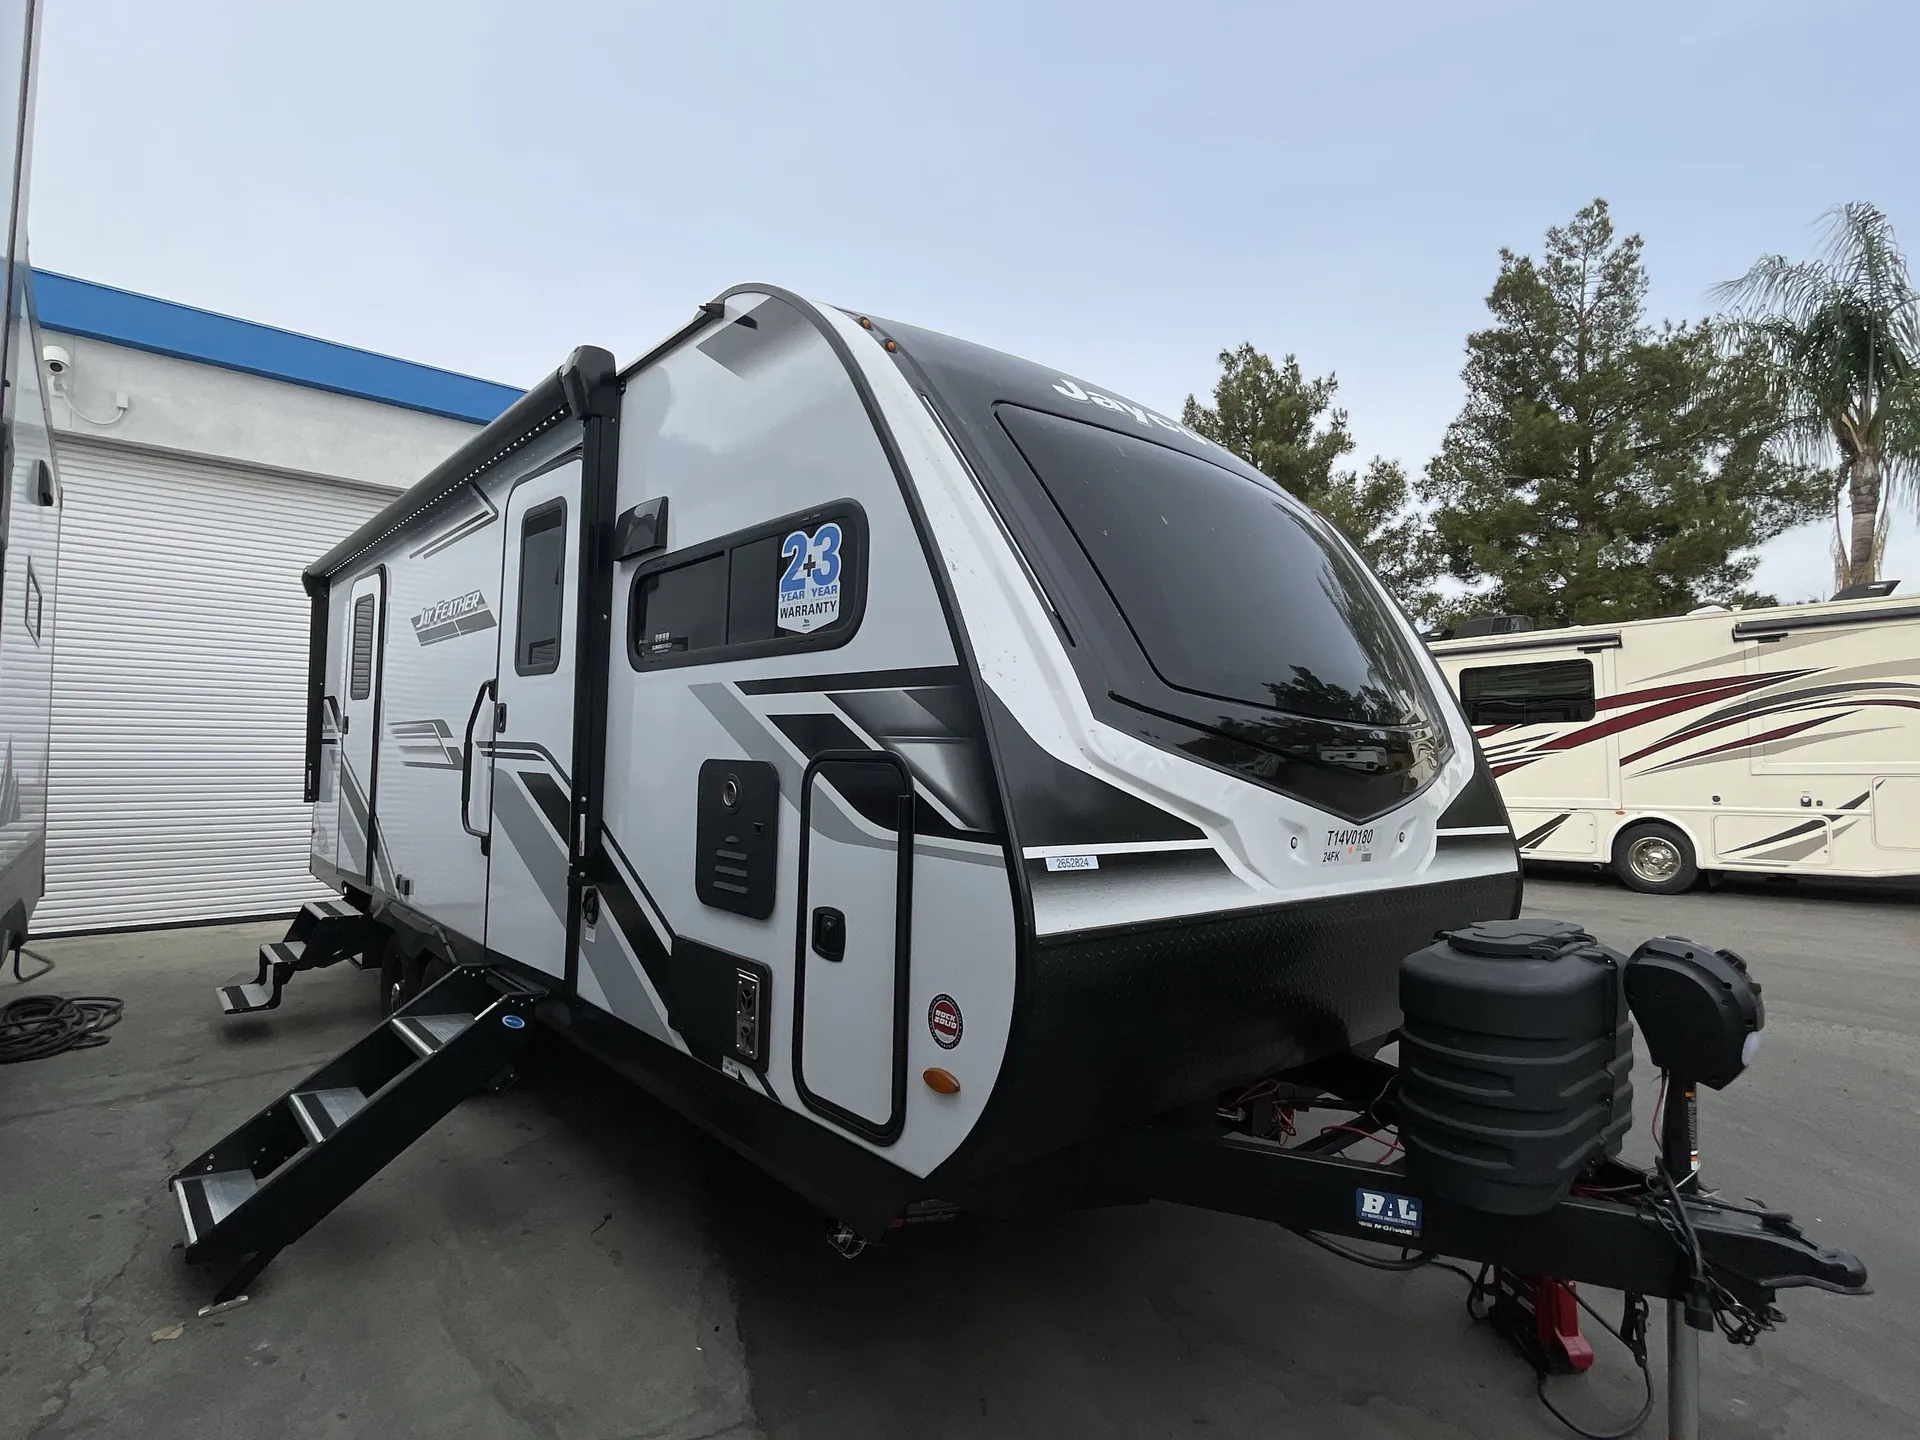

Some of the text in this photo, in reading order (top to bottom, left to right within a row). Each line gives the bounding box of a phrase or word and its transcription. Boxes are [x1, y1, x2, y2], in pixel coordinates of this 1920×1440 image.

[1052, 379, 1207, 445] Jayco
[781, 585, 838, 602] YEAR YEAR
[415, 591, 480, 628] JAY FEATHER
[780, 600, 838, 619] WARRANTY
[1327, 829, 1373, 846] T14V0180
[1056, 858, 1089, 869] 2652824
[1322, 851, 1340, 863] 24FK
[933, 1016, 957, 1029] SOLID
[935, 1009, 956, 1021] ROCK
[1362, 1192, 1418, 1221] BAL
